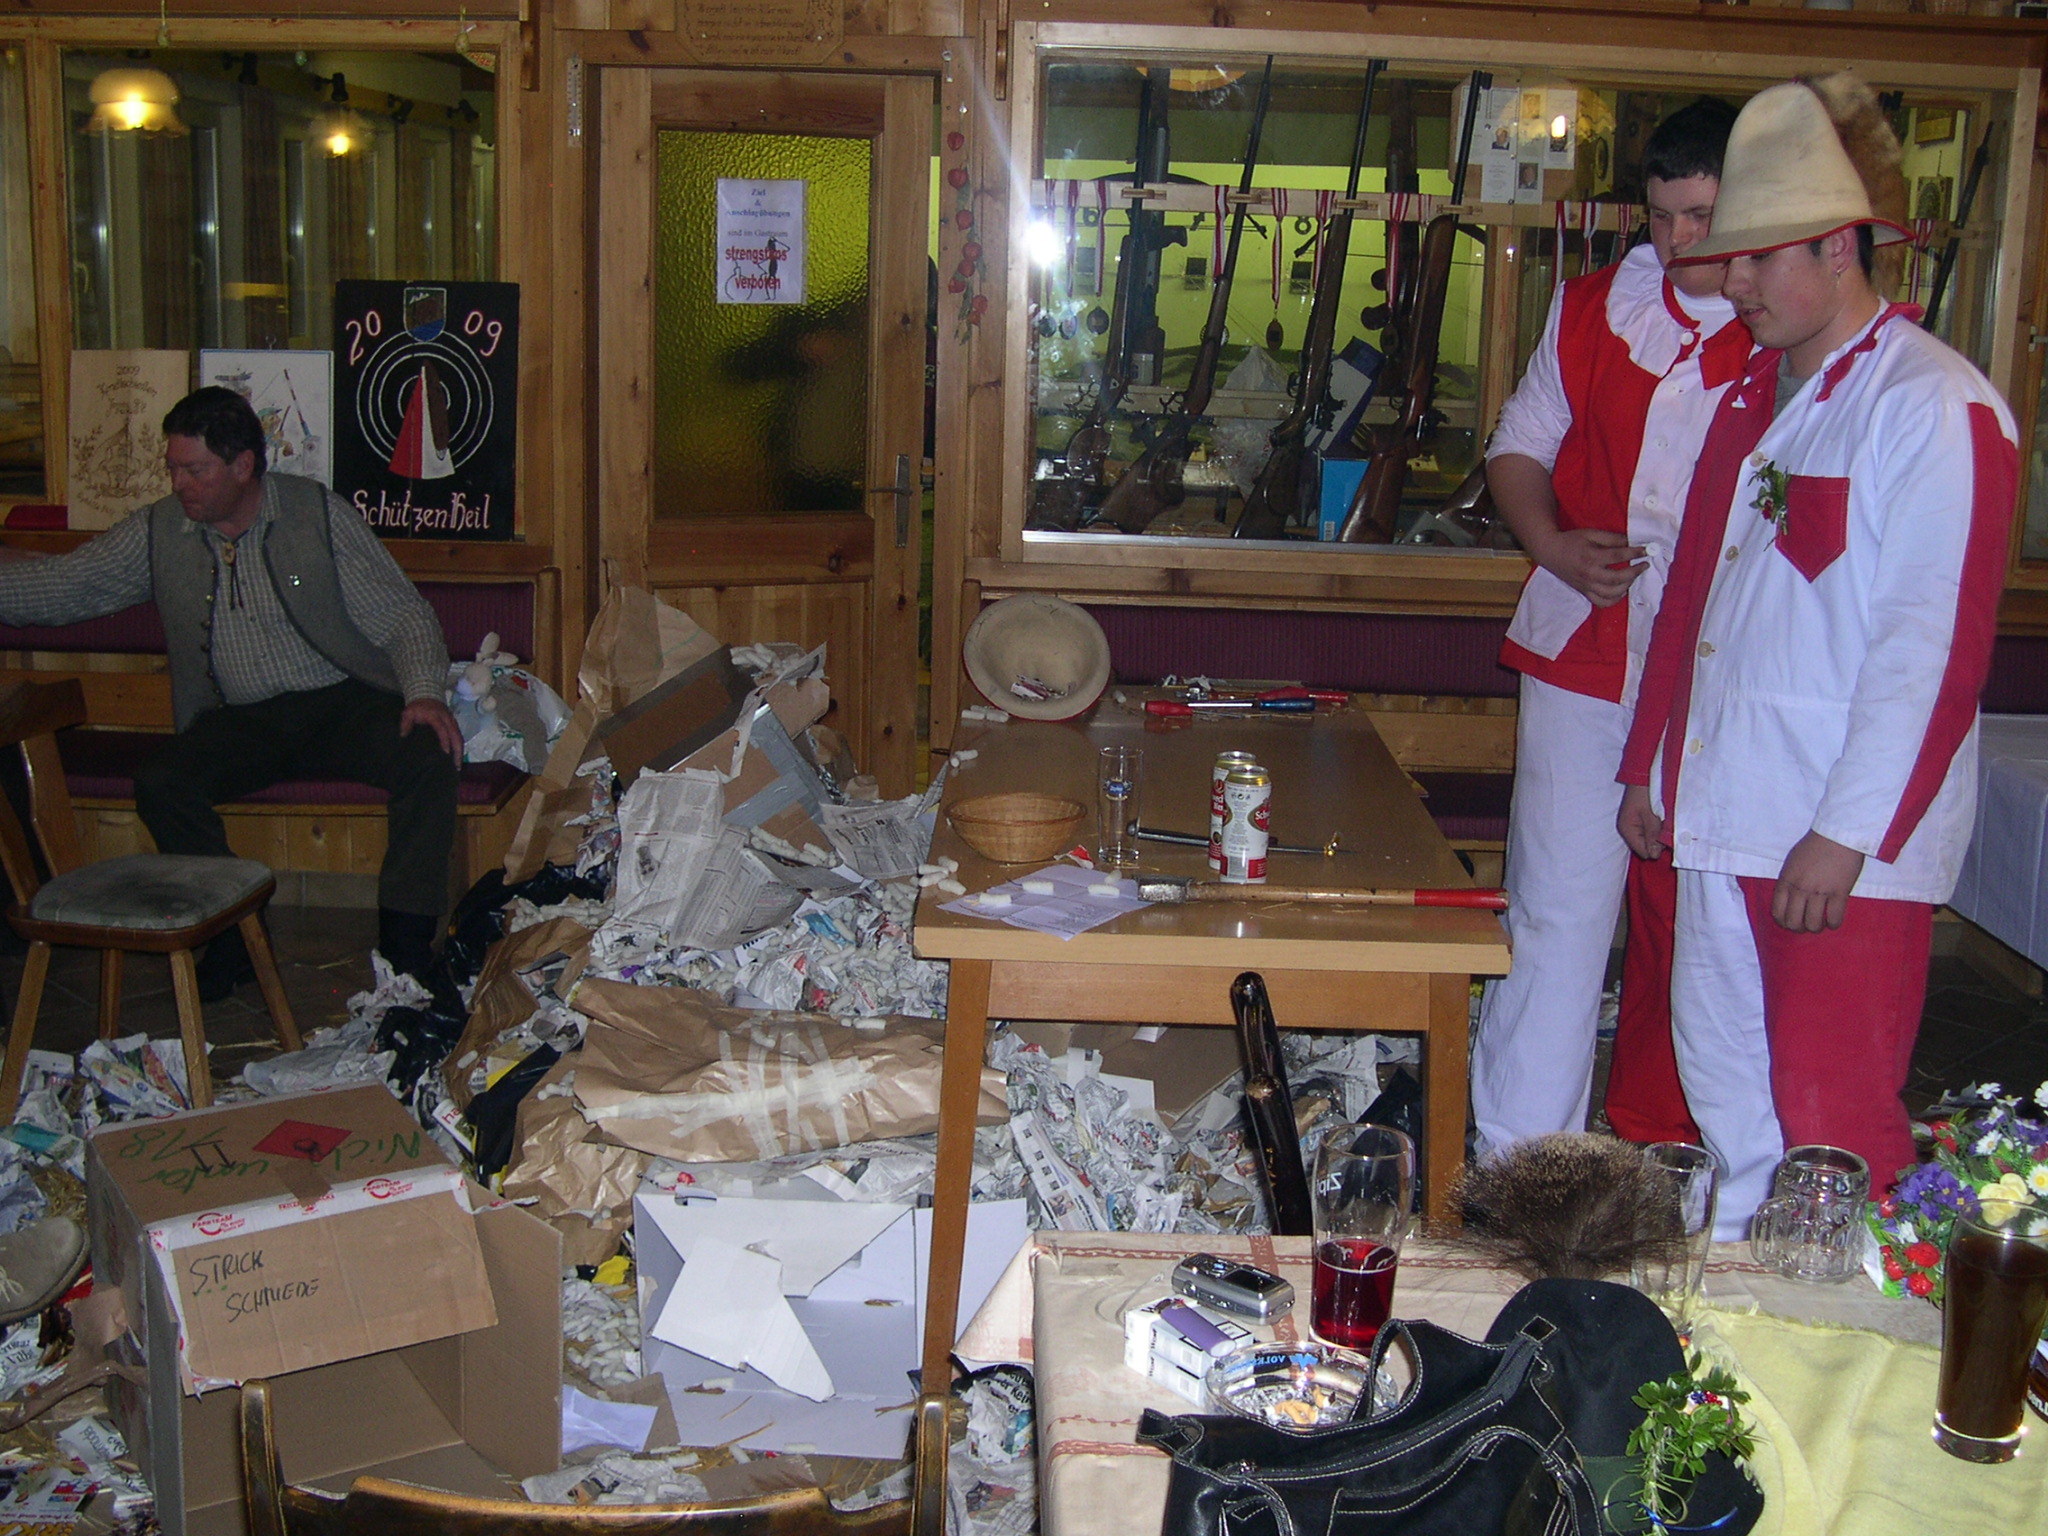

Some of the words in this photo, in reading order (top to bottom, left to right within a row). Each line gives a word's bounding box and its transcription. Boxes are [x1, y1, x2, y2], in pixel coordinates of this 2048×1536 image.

[751, 188, 766, 196] Ziel
[735, 274, 781, 289] verboten
[189, 1249, 264, 1296] STRICK
